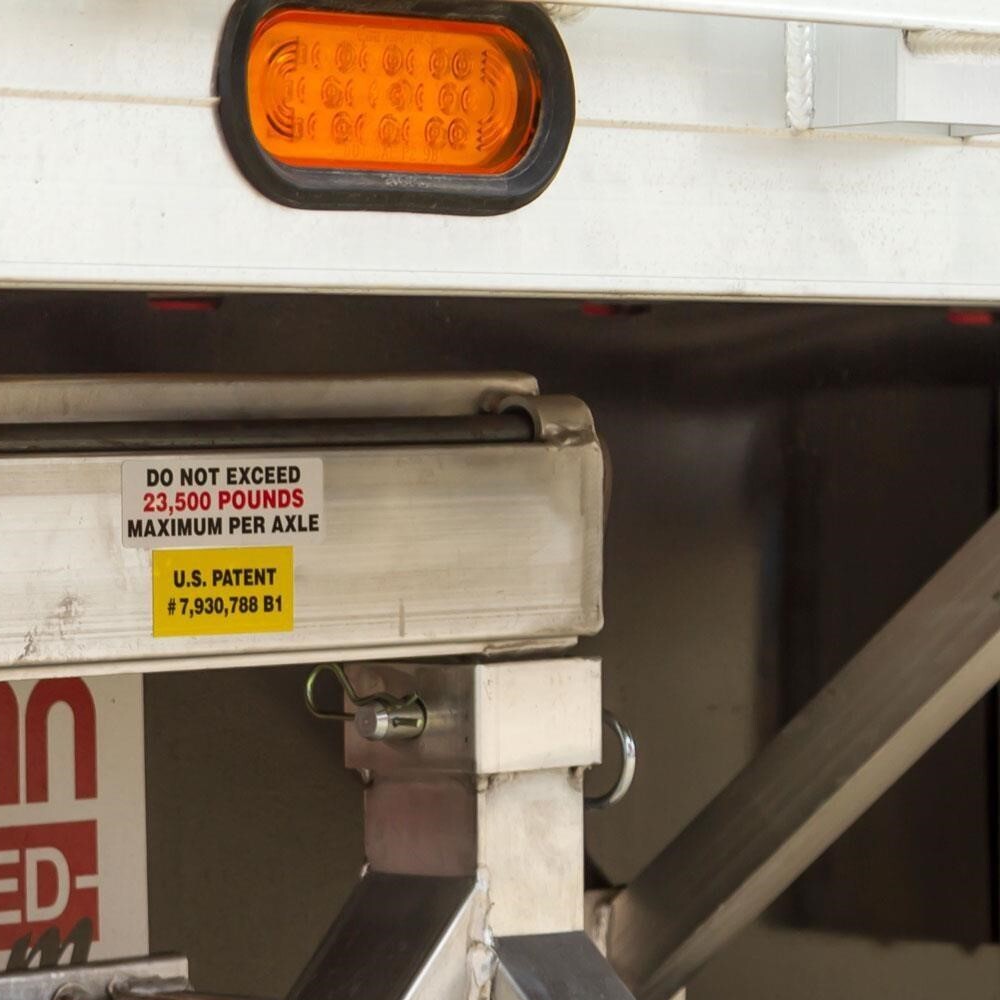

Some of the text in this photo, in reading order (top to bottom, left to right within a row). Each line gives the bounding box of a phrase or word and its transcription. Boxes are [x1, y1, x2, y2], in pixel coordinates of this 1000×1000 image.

[146, 465, 301, 487] DO NOT EXCEED
[143, 488, 304, 515] 23,500 POUNDS
[127, 514, 319, 538] MAXIMUM PER AXLE
[173, 567, 277, 588] U.S. PATENT
[263, 595, 282, 613] B1
